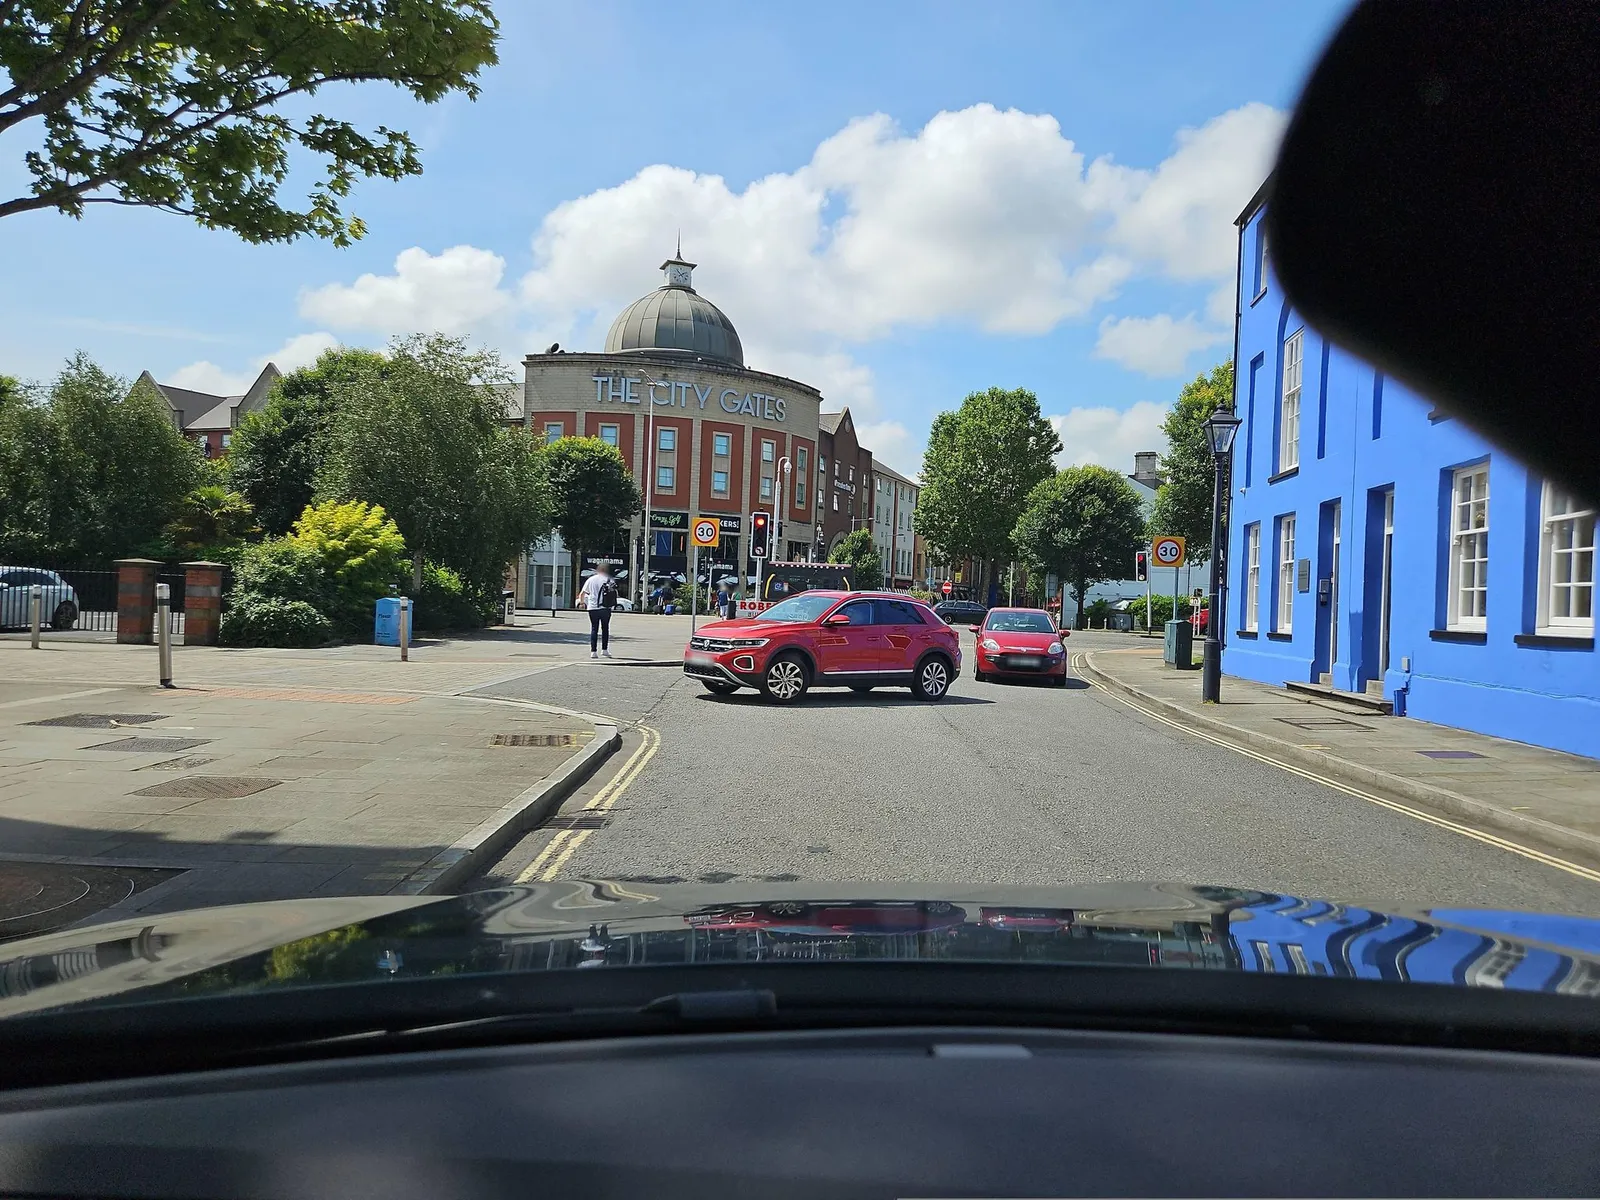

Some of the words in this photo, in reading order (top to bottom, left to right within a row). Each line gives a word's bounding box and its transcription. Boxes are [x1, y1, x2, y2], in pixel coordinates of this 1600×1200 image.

[592, 376, 641, 404] THE
[651, 380, 713, 409] CITY
[719, 387, 787, 422] GATES
[668, 514, 682, 526] Golf
[719, 520, 740, 529] KERS!
[697, 527, 714, 537] 30
[1160, 546, 1178, 557] 30
[587, 557, 624, 566] wagamama
[740, 601, 772, 610] ROBE
